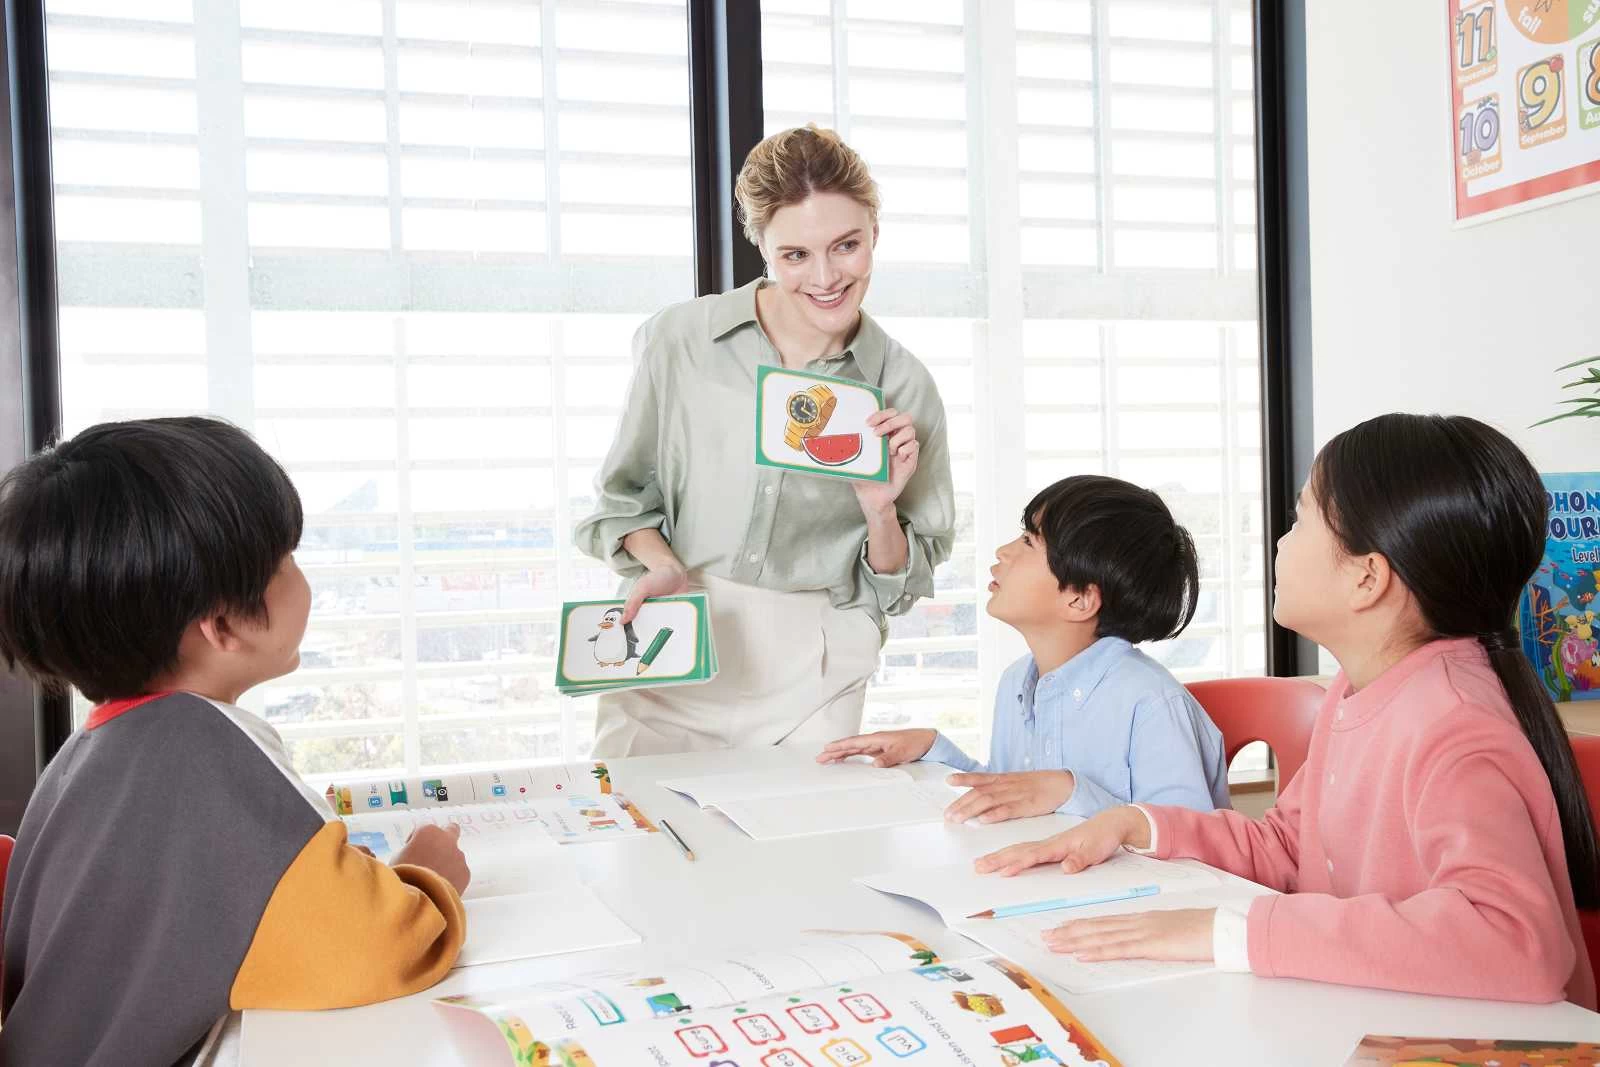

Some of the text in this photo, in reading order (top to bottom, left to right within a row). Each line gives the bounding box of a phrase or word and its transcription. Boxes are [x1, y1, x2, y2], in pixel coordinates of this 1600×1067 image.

[1458, 6, 1494, 67] 11
[1520, 60, 1560, 130] 9
[1460, 107, 1500, 155] 10
[1546, 516, 1600, 540] OUR
[1571, 545, 1600, 563] Level
[748, 1018, 772, 1039] sure
[835, 1045, 864, 1062] pic
